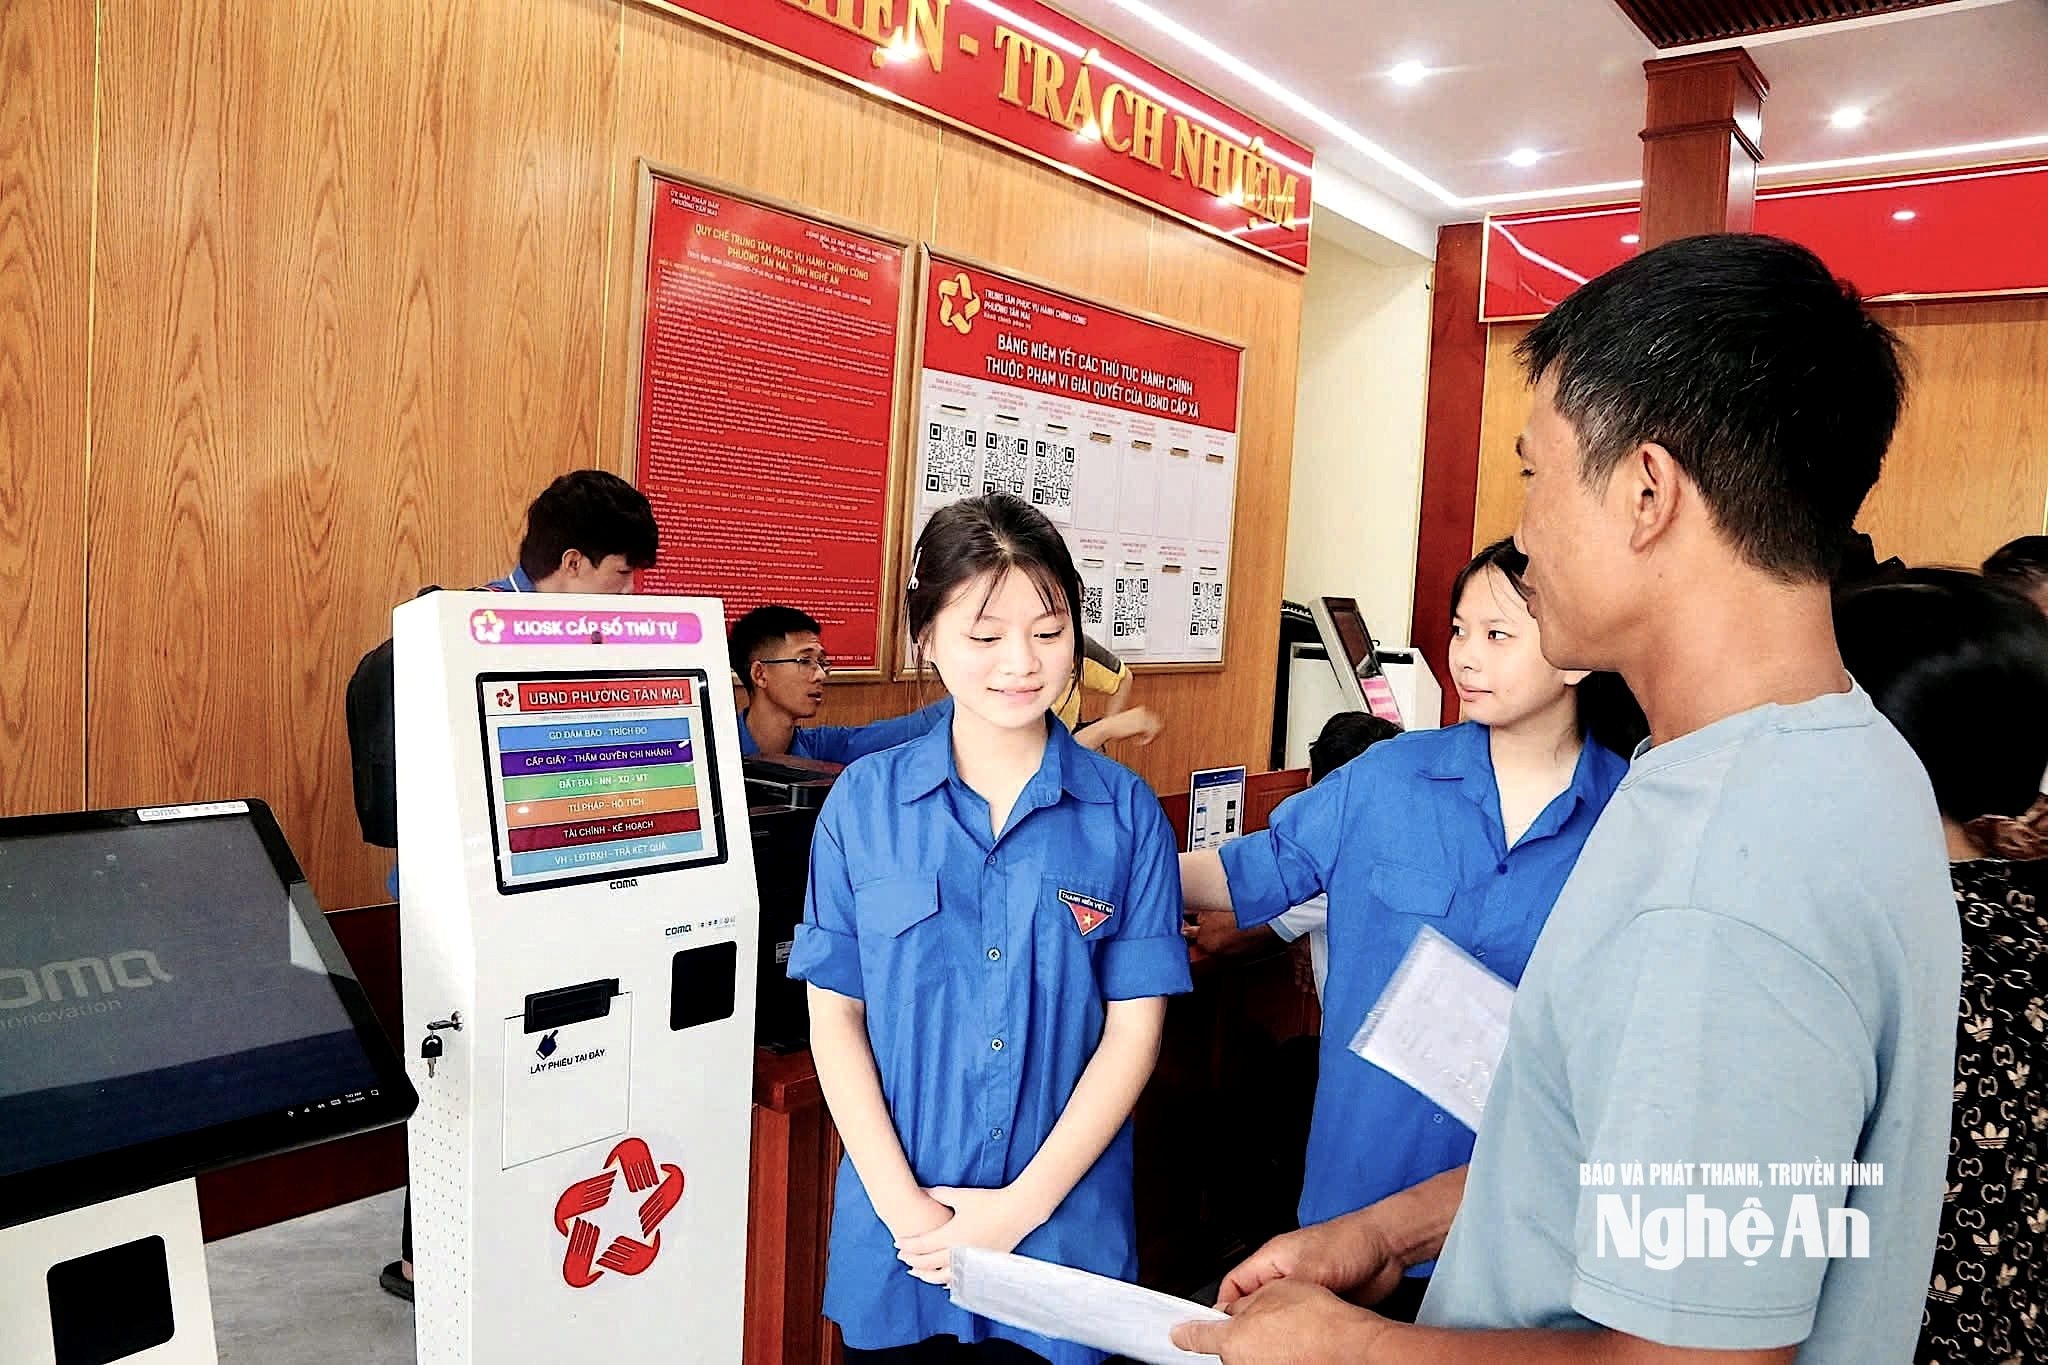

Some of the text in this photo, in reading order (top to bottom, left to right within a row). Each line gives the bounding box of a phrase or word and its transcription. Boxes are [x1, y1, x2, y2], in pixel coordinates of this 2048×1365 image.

[994, 25, 1167, 170] TRÁCH
[1170, 116, 1298, 231] NHIỆM
[695, 223, 712, 237] QUY
[731, 233, 756, 249] TRUNG
[757, 239, 772, 254] TÂM
[806, 253, 826, 268] HÀNH
[827, 260, 849, 275] CHÍNH
[850, 266, 869, 281] CÔNG
[727, 246, 760, 263] PHƯỜNG
[760, 255, 774, 268] TÂN
[829, 275, 840, 286] AN
[984, 288, 1004, 302] TRUNG
[984, 300, 1008, 315] PHƯỜNG
[1020, 311, 1031, 321] MAI
[997, 331, 1194, 397] BẢNG NIÊM YẾT CÁC THỦ TỤC HÀNH CHÍNH
[985, 356, 1025, 383] THUỘC
[1026, 365, 1057, 389] PHẠM
[1058, 372, 1069, 391] VI
[1070, 374, 1091, 395] GIẢI
[1093, 380, 1124, 401] QUYẾT
[1124, 386, 1143, 406] CỦA
[1144, 392, 1169, 411] UBND
[1170, 396, 1188, 415] CẤP
[513, 615, 679, 640] KIOSK CẤP SỐ THỨ TỰ
[528, 691, 568, 705] UBND
[571, 688, 631, 704] PHƯỜNG
[632, 685, 658, 701] TÂN
[549, 731, 562, 740] GD
[608, 726, 634, 736] TRÍCH
[525, 754, 544, 767] CẤP
[545, 753, 567, 765] GIẤY
[574, 750, 598, 763] THẨM
[599, 748, 628, 761] QUYỀN
[629, 750, 644, 759] CHI
[559, 778, 577, 789] ĐẤT
[578, 778, 593, 787] ĐAI
[599, 776, 612, 785] NN
[636, 773, 649, 782] MT
[582, 800, 604, 811] PHÁP
[563, 828, 578, 839] TÀI
[578, 825, 606, 837] CHÍNH
[612, 822, 623, 833] KẾ
[625, 820, 654, 832] HOẠCH
[555, 855, 568, 865] VH
[574, 850, 609, 862] LĐTBXH
[609, 878, 639, 890] coma
[665, 924, 692, 936] coma
